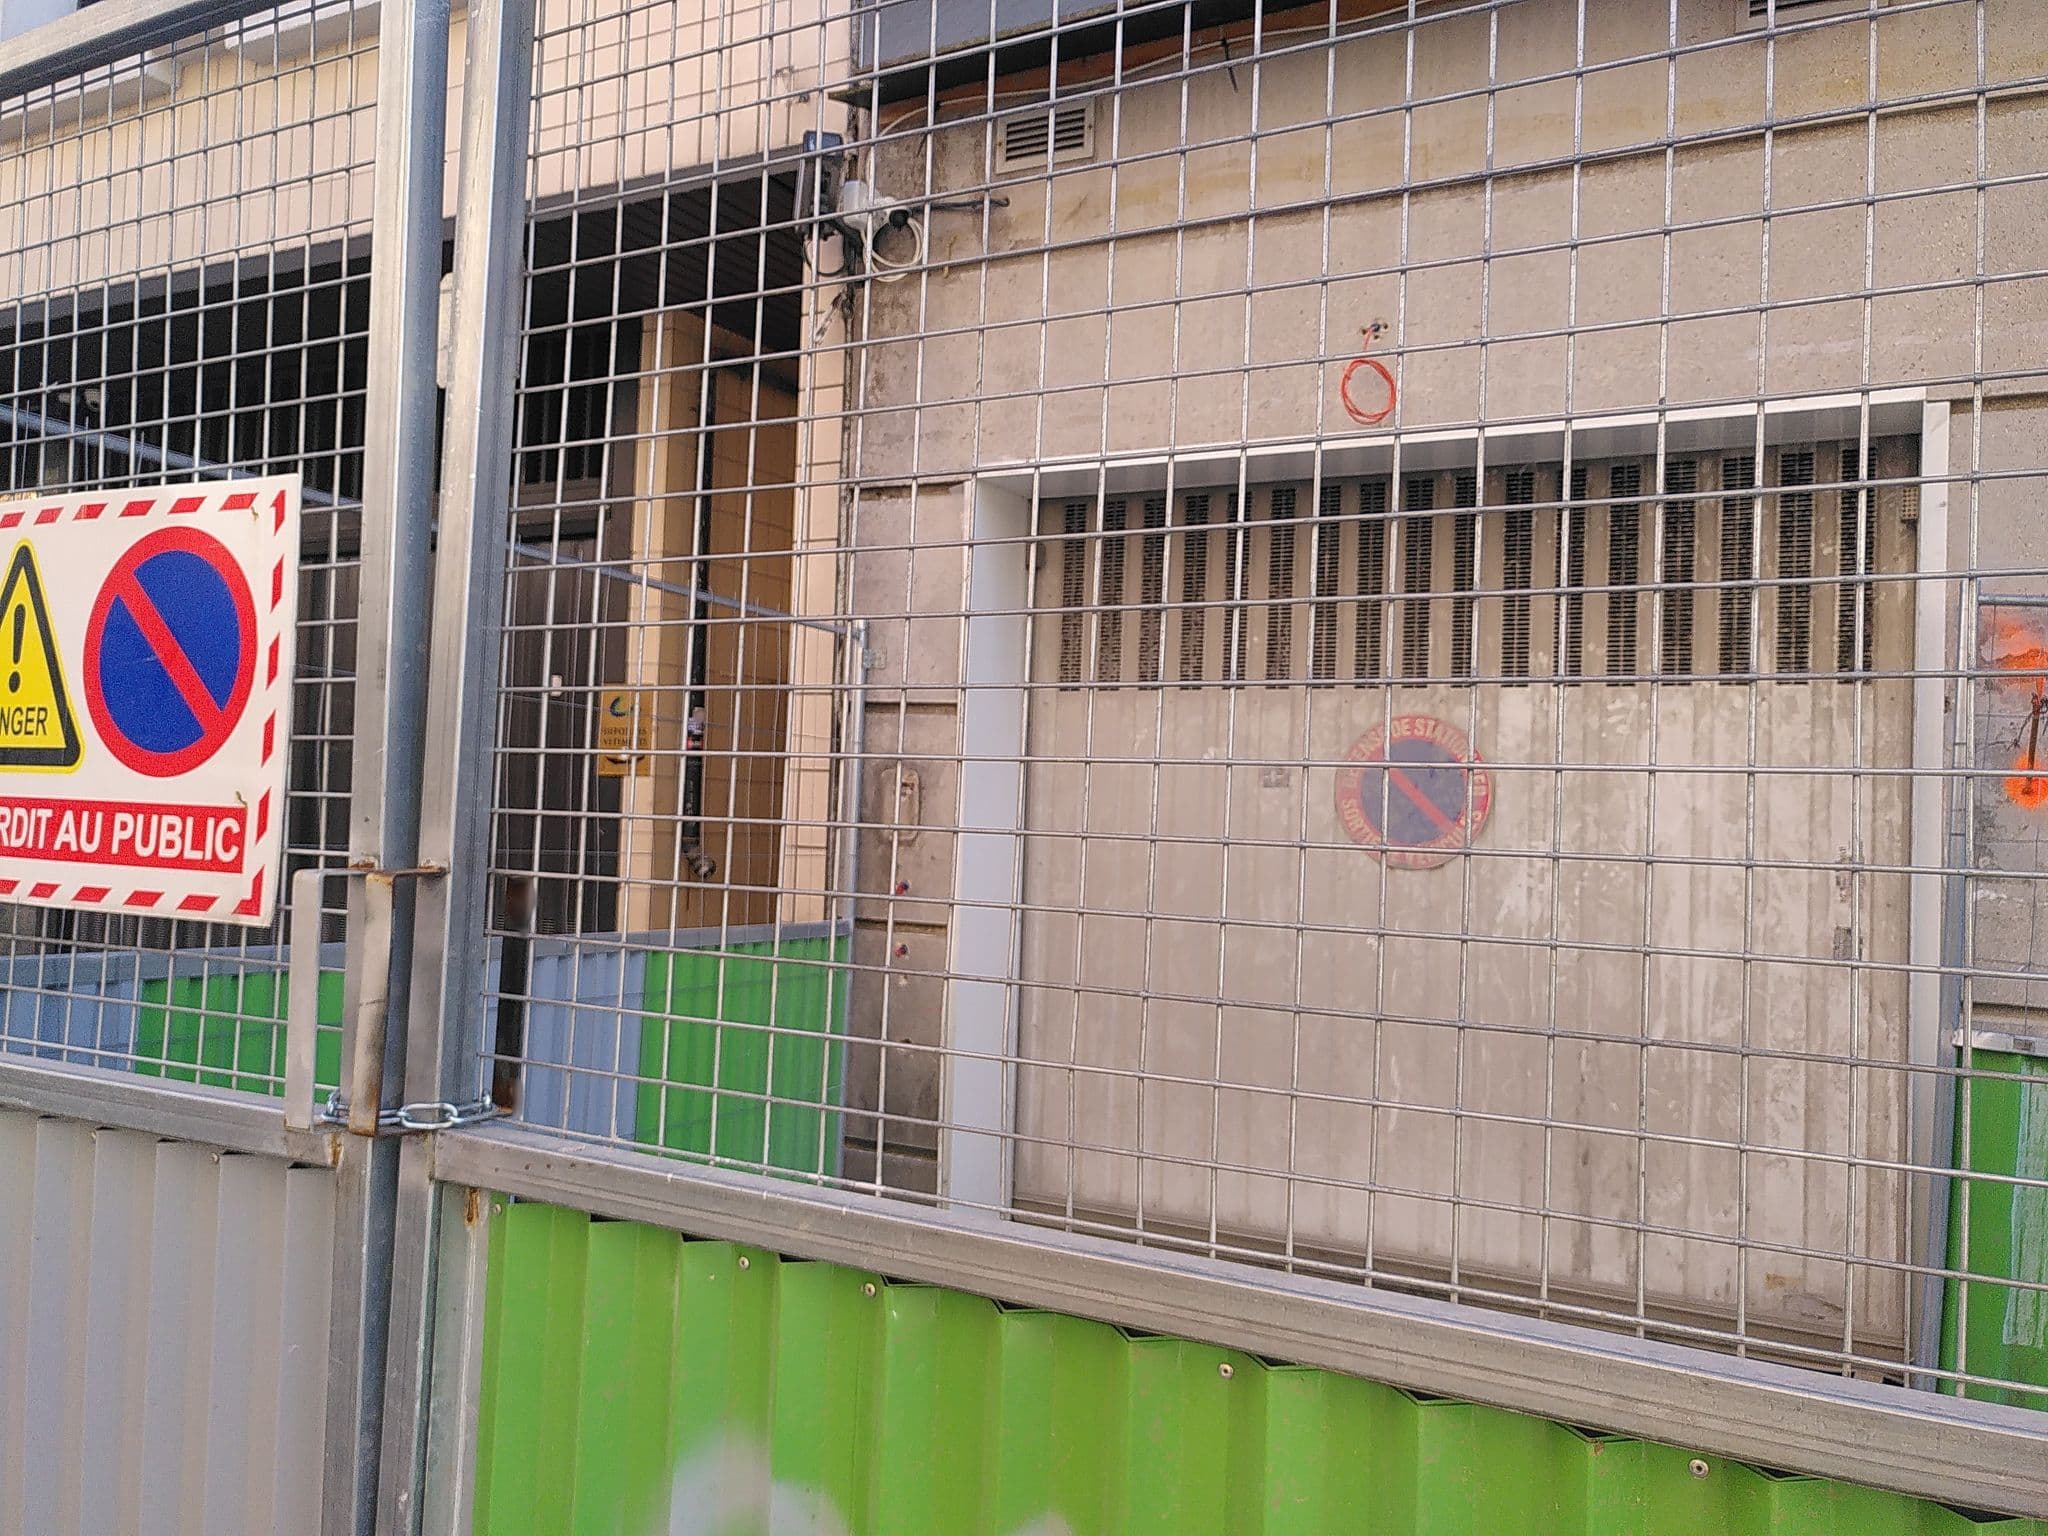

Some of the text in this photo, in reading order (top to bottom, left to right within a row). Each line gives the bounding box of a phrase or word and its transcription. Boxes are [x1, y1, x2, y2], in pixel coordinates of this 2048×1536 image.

[0, 706, 48, 736] NGER
[53, 809, 102, 854] AU
[111, 812, 241, 863] PUBLIC
